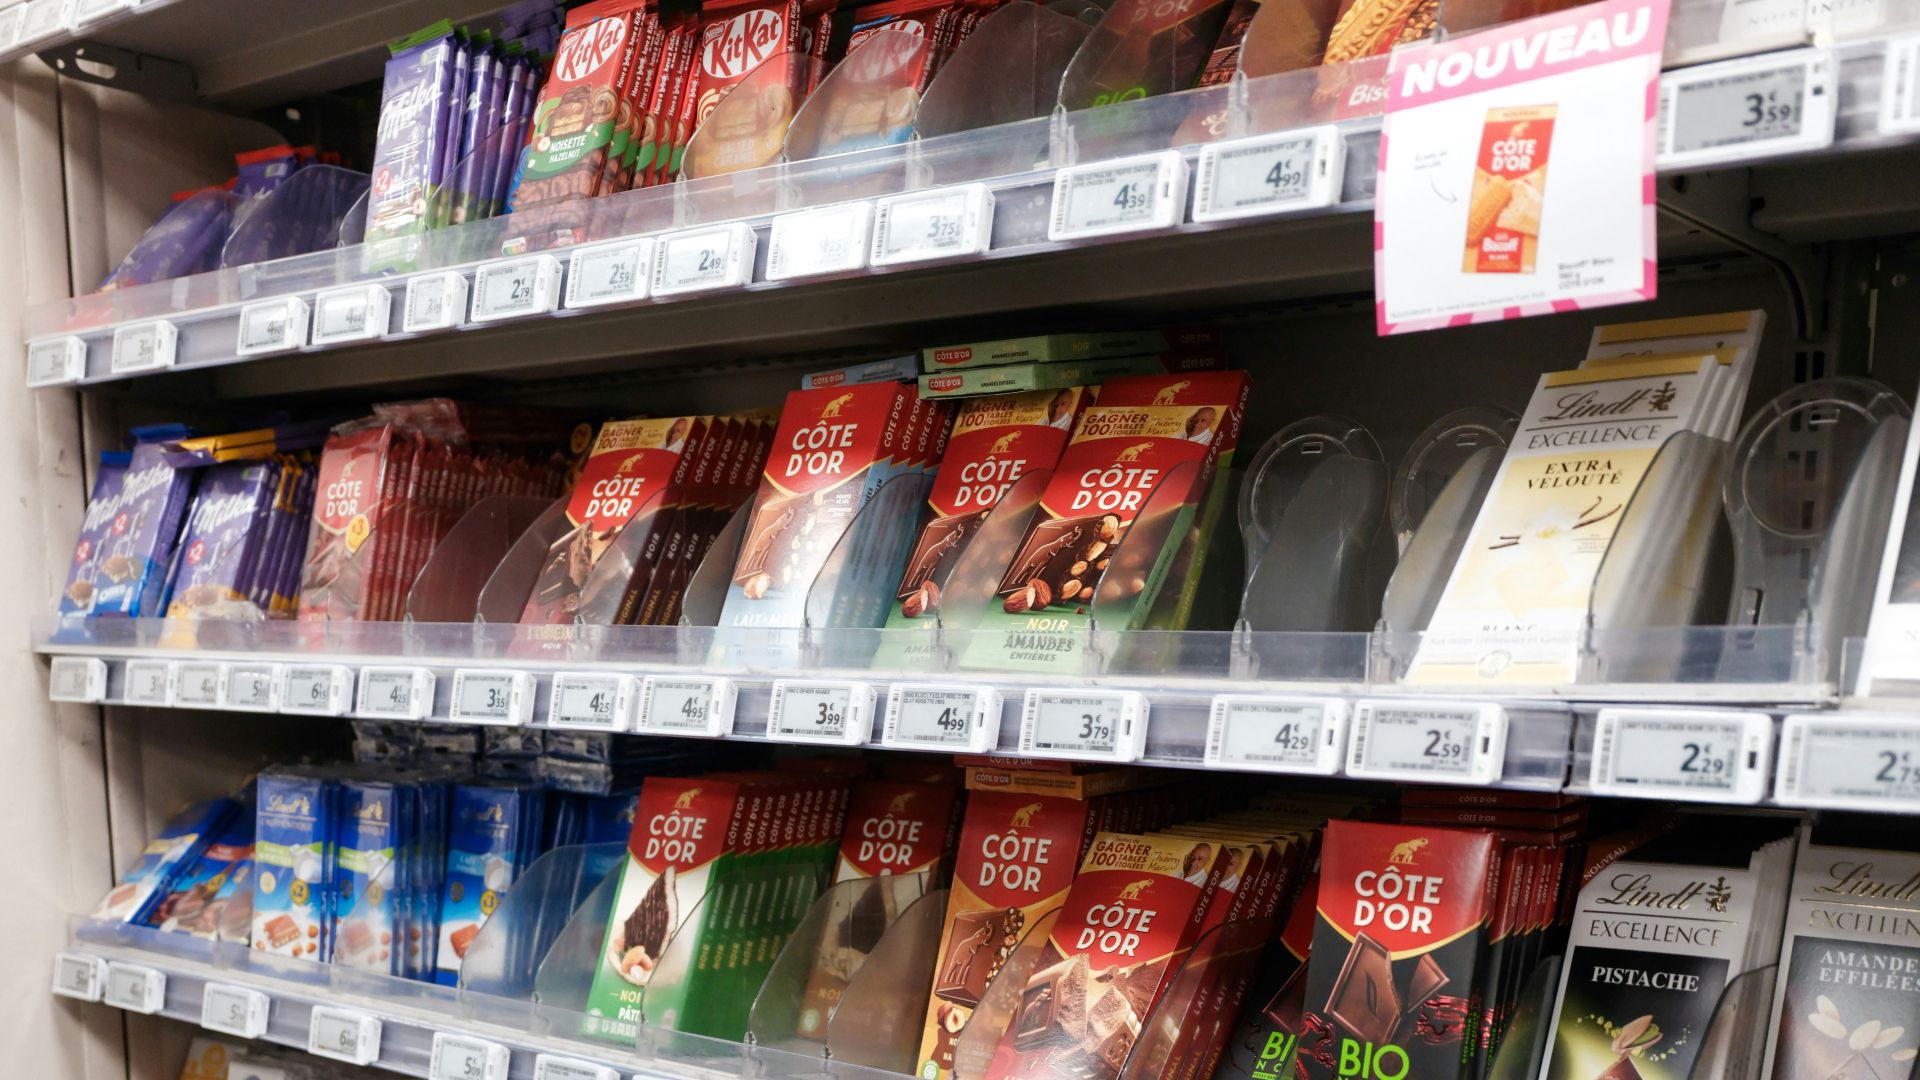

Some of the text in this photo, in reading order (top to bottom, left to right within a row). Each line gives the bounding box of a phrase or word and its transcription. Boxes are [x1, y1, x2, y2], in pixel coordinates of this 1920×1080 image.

[561, 18, 625, 80] KitKat
[711, 12, 780, 76] KitKat
[1401, 7, 1650, 97] NOUVEAU
[550, 135, 587, 153] NOISETTE
[550, 149, 581, 164] HAZELNUT
[1493, 137, 1536, 157] CÔTE
[1491, 156, 1532, 171] D'OR
[1540, 389, 1652, 422] Lindt
[960, 413, 984, 428] 100
[1081, 424, 1111, 436] 100
[1086, 413, 1149, 424] GAGNER
[792, 419, 858, 451] CÔTE
[1528, 424, 1662, 449] EXCELLENCE
[785, 451, 845, 478] D'OR
[961, 456, 1026, 483] CÔTE
[1080, 464, 1159, 488] CÔTE
[1545, 460, 1613, 475] EXTRA
[120, 463, 175, 506] Milka
[327, 479, 362, 500] CÔTE
[593, 473, 645, 497] CÔTE
[1527, 471, 1624, 490] VELOUTÉ
[193, 491, 258, 535] Milka
[326, 499, 358, 518] D'OR
[585, 498, 632, 518] D'OR
[1071, 490, 1143, 511] D'OR
[1027, 617, 1069, 631] NOIR
[1004, 635, 1075, 653] AMANDES
[1010, 651, 1056, 662] ENTIÈRES
[650, 809, 708, 840] CÔTE
[863, 813, 923, 842] CÔTE
[645, 841, 697, 864] D'OR
[859, 844, 914, 865] D'OR
[983, 829, 1052, 865] CÔTE
[1089, 852, 1148, 866] 100 TABLES
[1096, 841, 1151, 856] GAGNER
[1583, 844, 1627, 880] NOUVEAU
[979, 863, 1042, 893] D'OR
[1355, 865, 1444, 905] CÔTE
[1596, 873, 1706, 911] Lindt
[1086, 900, 1157, 933] CÔTE
[1353, 902, 1432, 934] D'OR
[1076, 929, 1140, 957] D'OR
[1589, 919, 1722, 947] EXCELLENCE
[1820, 950, 1919, 974] AMANDE
[1592, 966, 1700, 993] PISTACHE
[1260, 1031, 1296, 1062] BI
[1338, 1038, 1410, 1080] BIO
